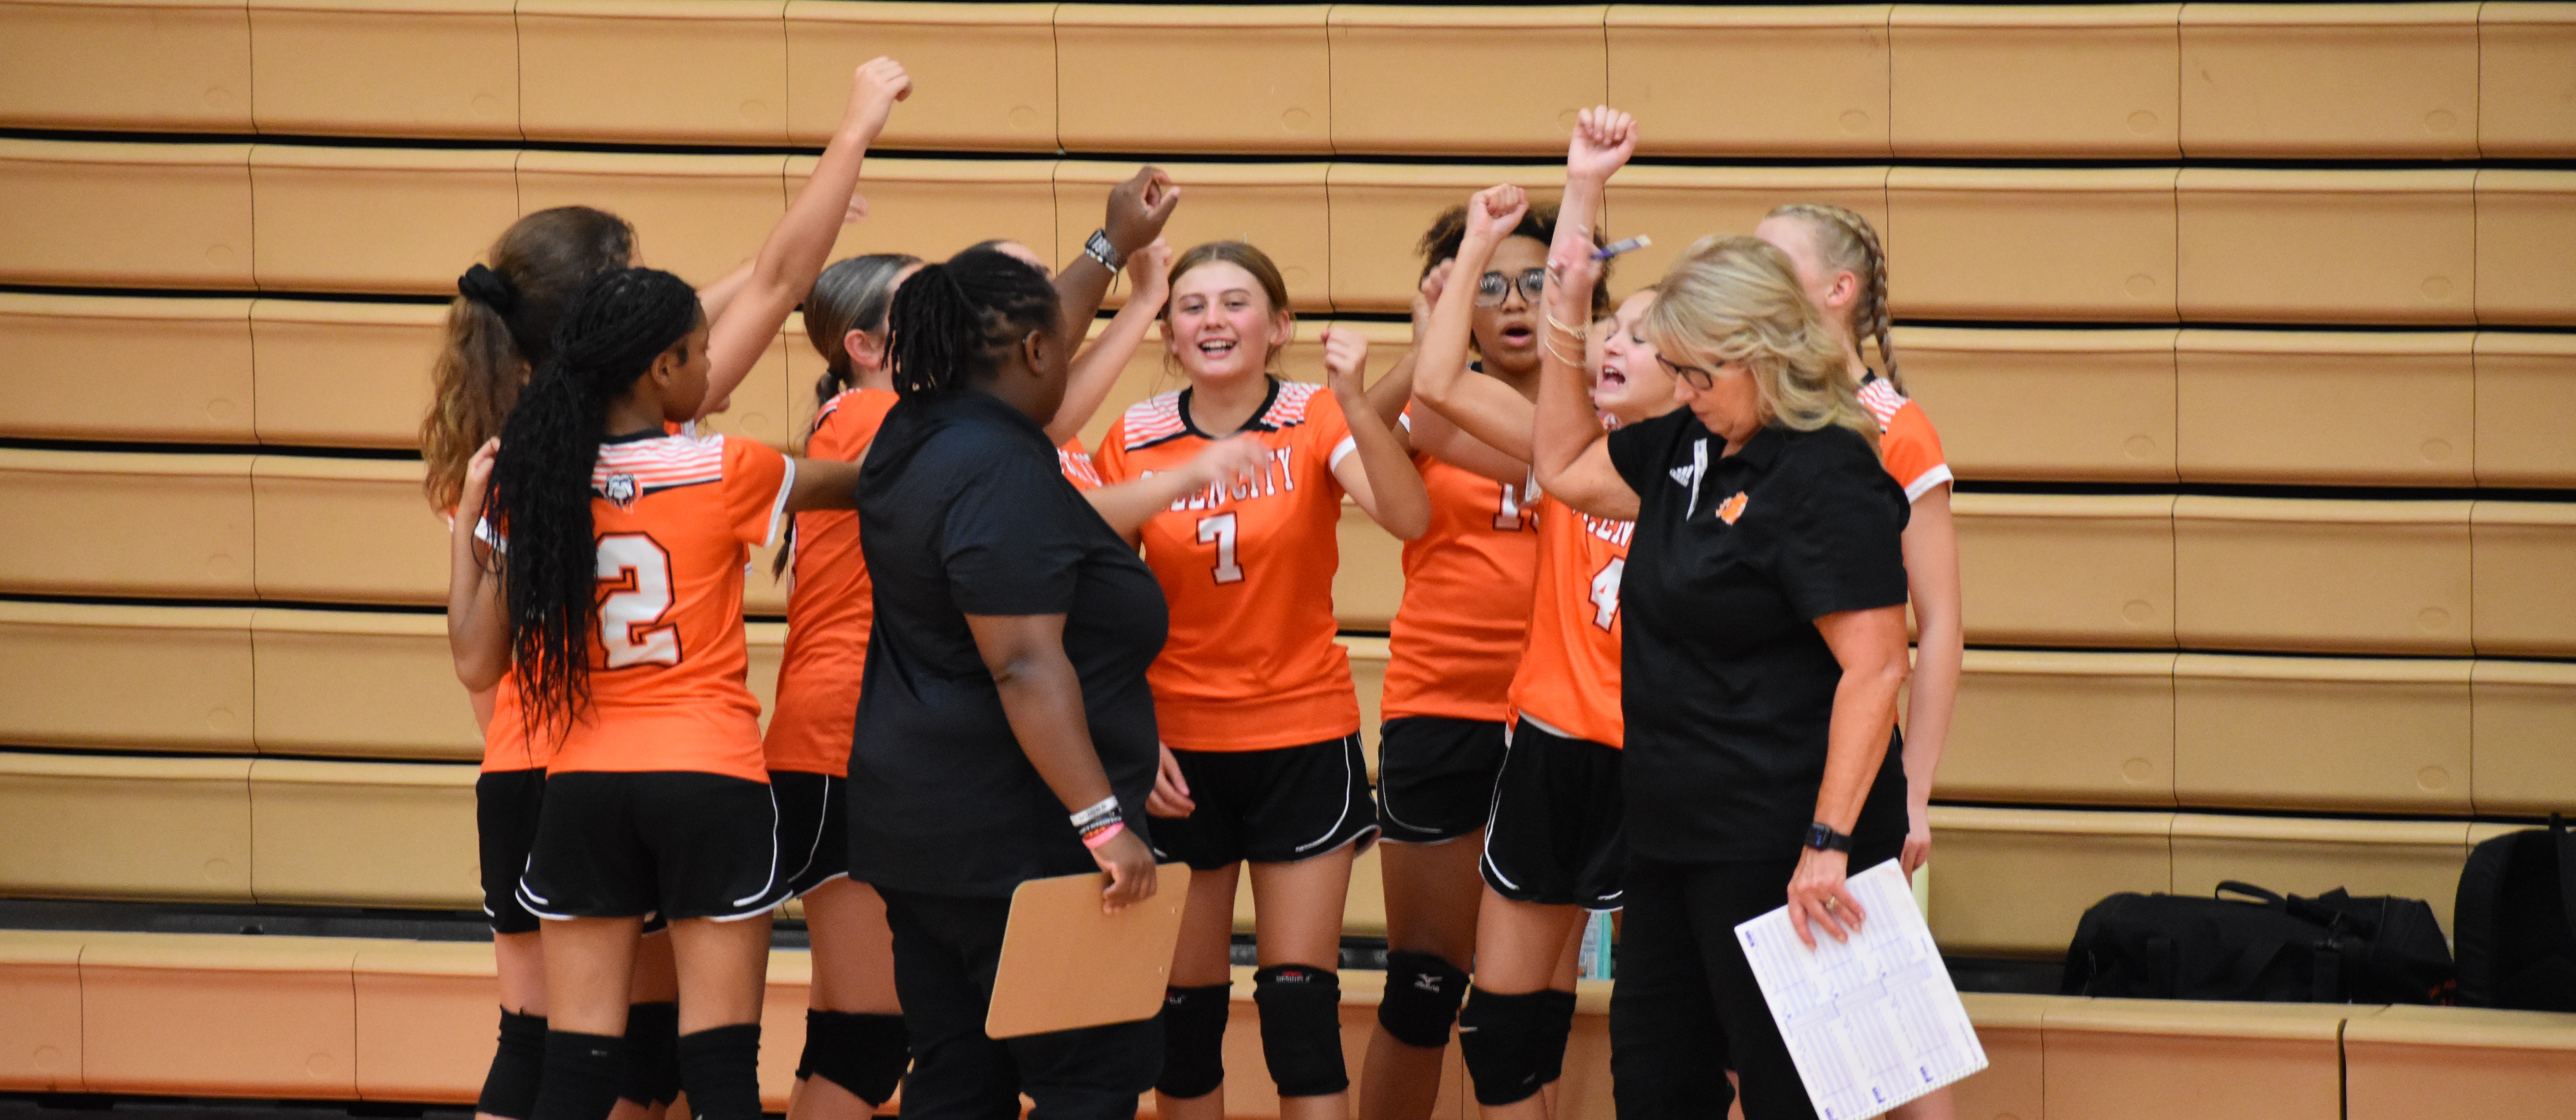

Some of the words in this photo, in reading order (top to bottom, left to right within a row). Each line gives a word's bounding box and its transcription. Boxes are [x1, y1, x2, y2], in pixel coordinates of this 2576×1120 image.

[1197, 511, 1245, 585] 7
[595, 531, 682, 671] 2
[1588, 554, 1626, 633] 4
